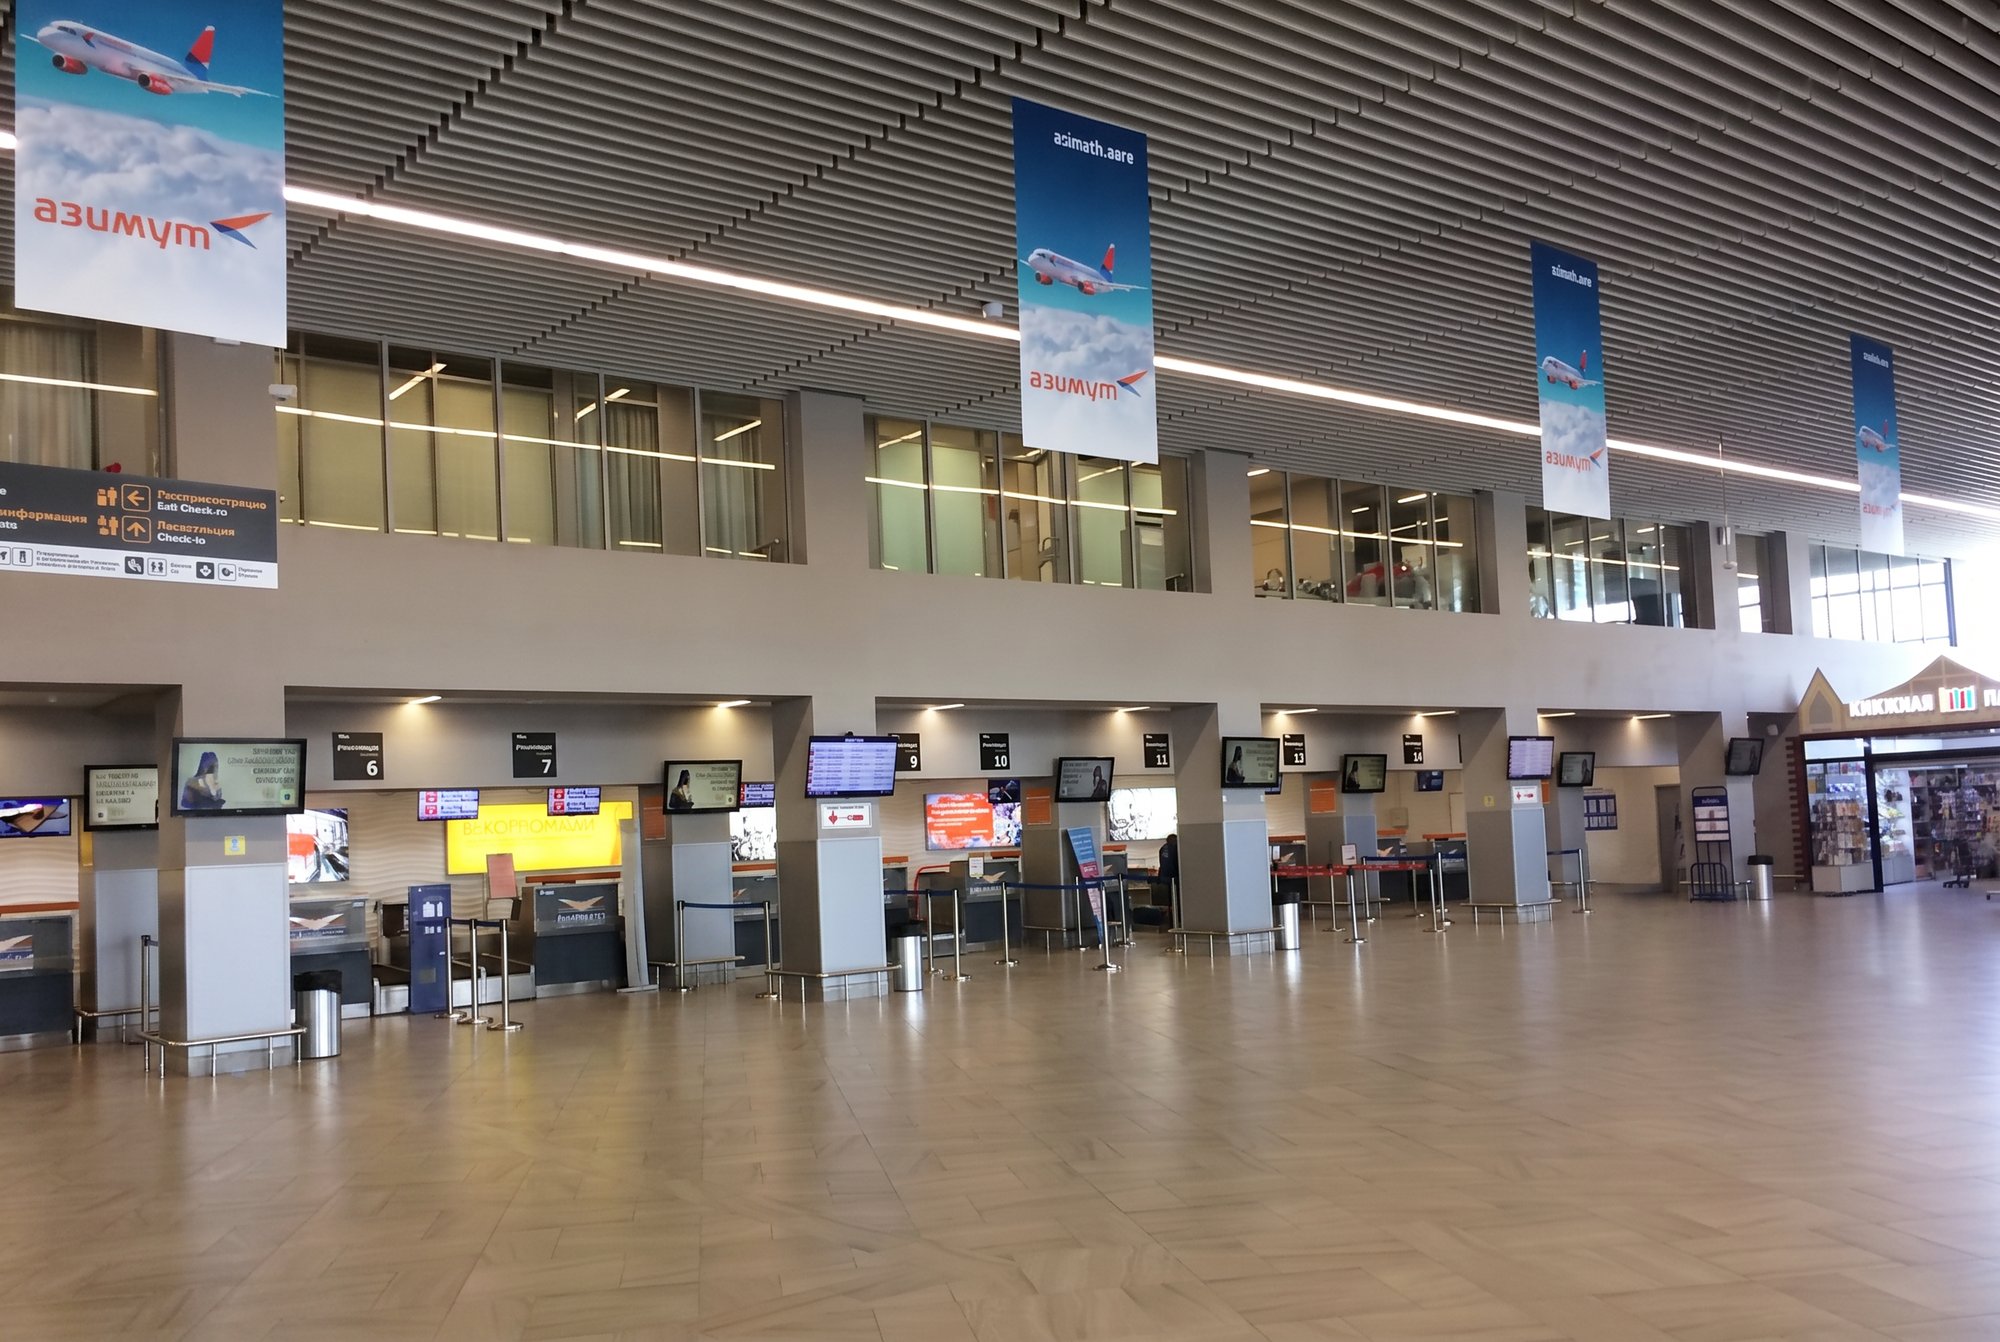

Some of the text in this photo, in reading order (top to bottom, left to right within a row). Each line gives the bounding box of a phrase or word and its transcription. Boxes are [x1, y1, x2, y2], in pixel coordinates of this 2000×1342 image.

[910, 755, 918, 768] 9
[994, 755, 1008, 767] 10
[1156, 754, 1168, 765] 11
[1294, 753, 1304, 763] 13
[366, 760, 378, 776] 6
[541, 758, 552, 774] 7
